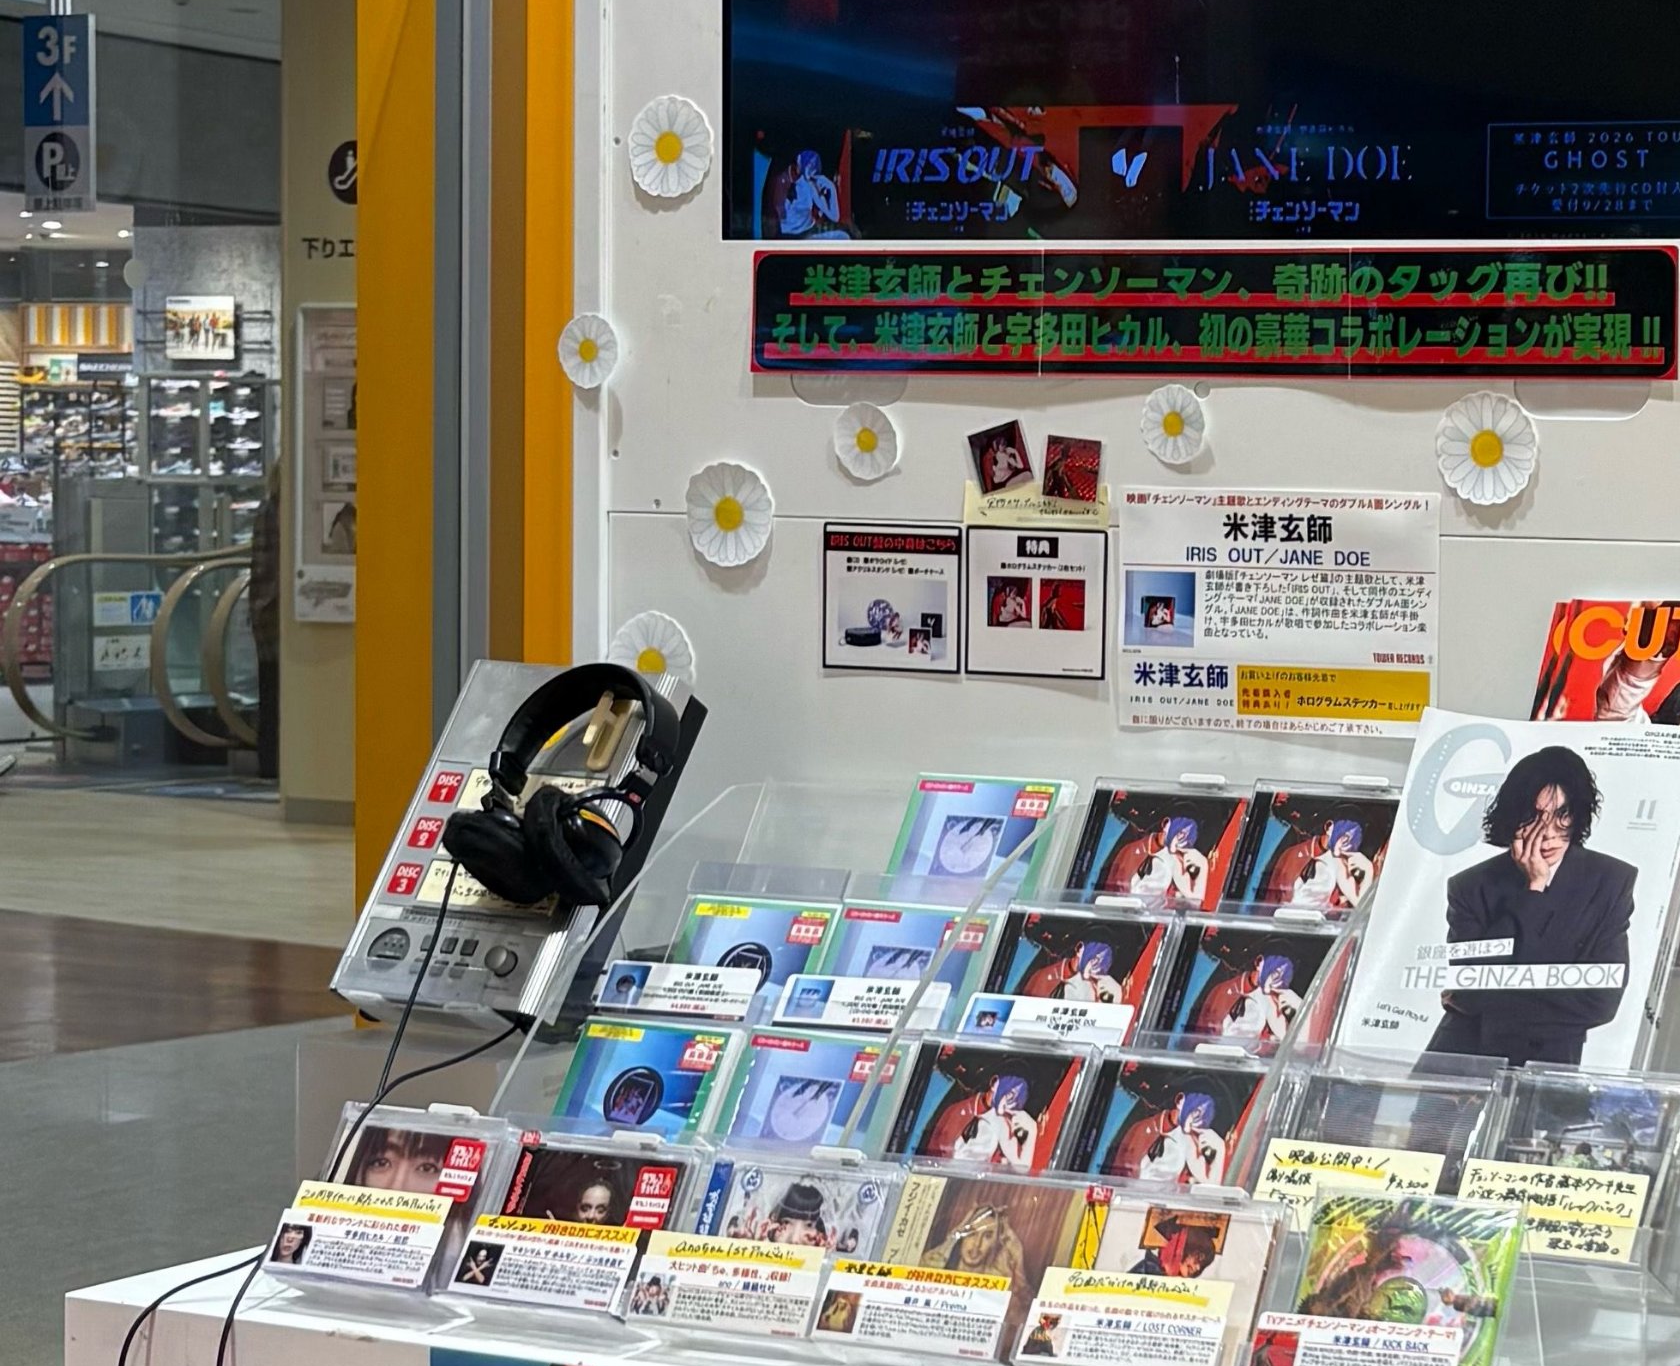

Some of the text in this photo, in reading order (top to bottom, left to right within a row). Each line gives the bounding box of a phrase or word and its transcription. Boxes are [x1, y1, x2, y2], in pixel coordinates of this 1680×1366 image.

[36, 25, 78, 66] 3F
[1588, 131, 1634, 144] 2026
[872, 146, 956, 184] IRIS
[1327, 144, 1413, 181] DOE
[1544, 148, 1650, 169] GHOST
[1222, 512, 1333, 544] 米津玄師
[1024, 539, 1052, 556] 特典
[1185, 546, 1371, 567] IRIS DOE
[1372, 652, 1425, 665] TOWER RECORDS
[1134, 662, 1229, 690] 米津玄師
[436, 773, 463, 787] DISC
[440, 787, 447, 800] 1
[416, 818, 442, 832] DISC
[418, 832, 428, 846] 2
[396, 864, 421, 877] DISC
[396, 878, 407, 893] 3
[1403, 964, 1622, 989] THE GINZA BOOK
[1143, 1322, 1167, 1334] LOST
[1167, 1323, 1203, 1336] CORNER
[1382, 1337, 1402, 1351] KICK
[1405, 1339, 1429, 1353] BACK
